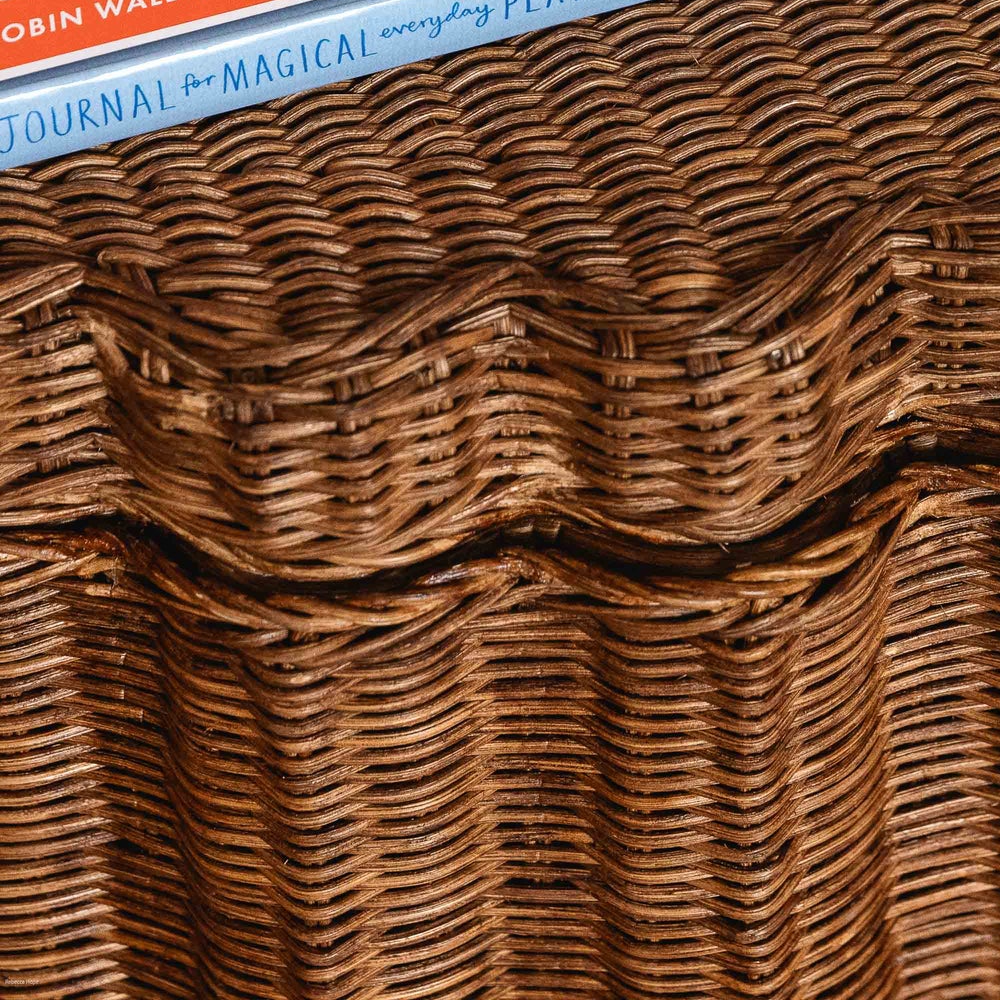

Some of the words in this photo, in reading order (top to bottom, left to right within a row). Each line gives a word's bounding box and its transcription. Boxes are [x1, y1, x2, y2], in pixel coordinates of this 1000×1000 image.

[1, 6, 83, 44] OBIN
[0, 79, 176, 154] JOURNAL
[180, 73, 217, 96] for
[221, 28, 379, 94] MAGICAL
[379, 1, 495, 40] everyday
